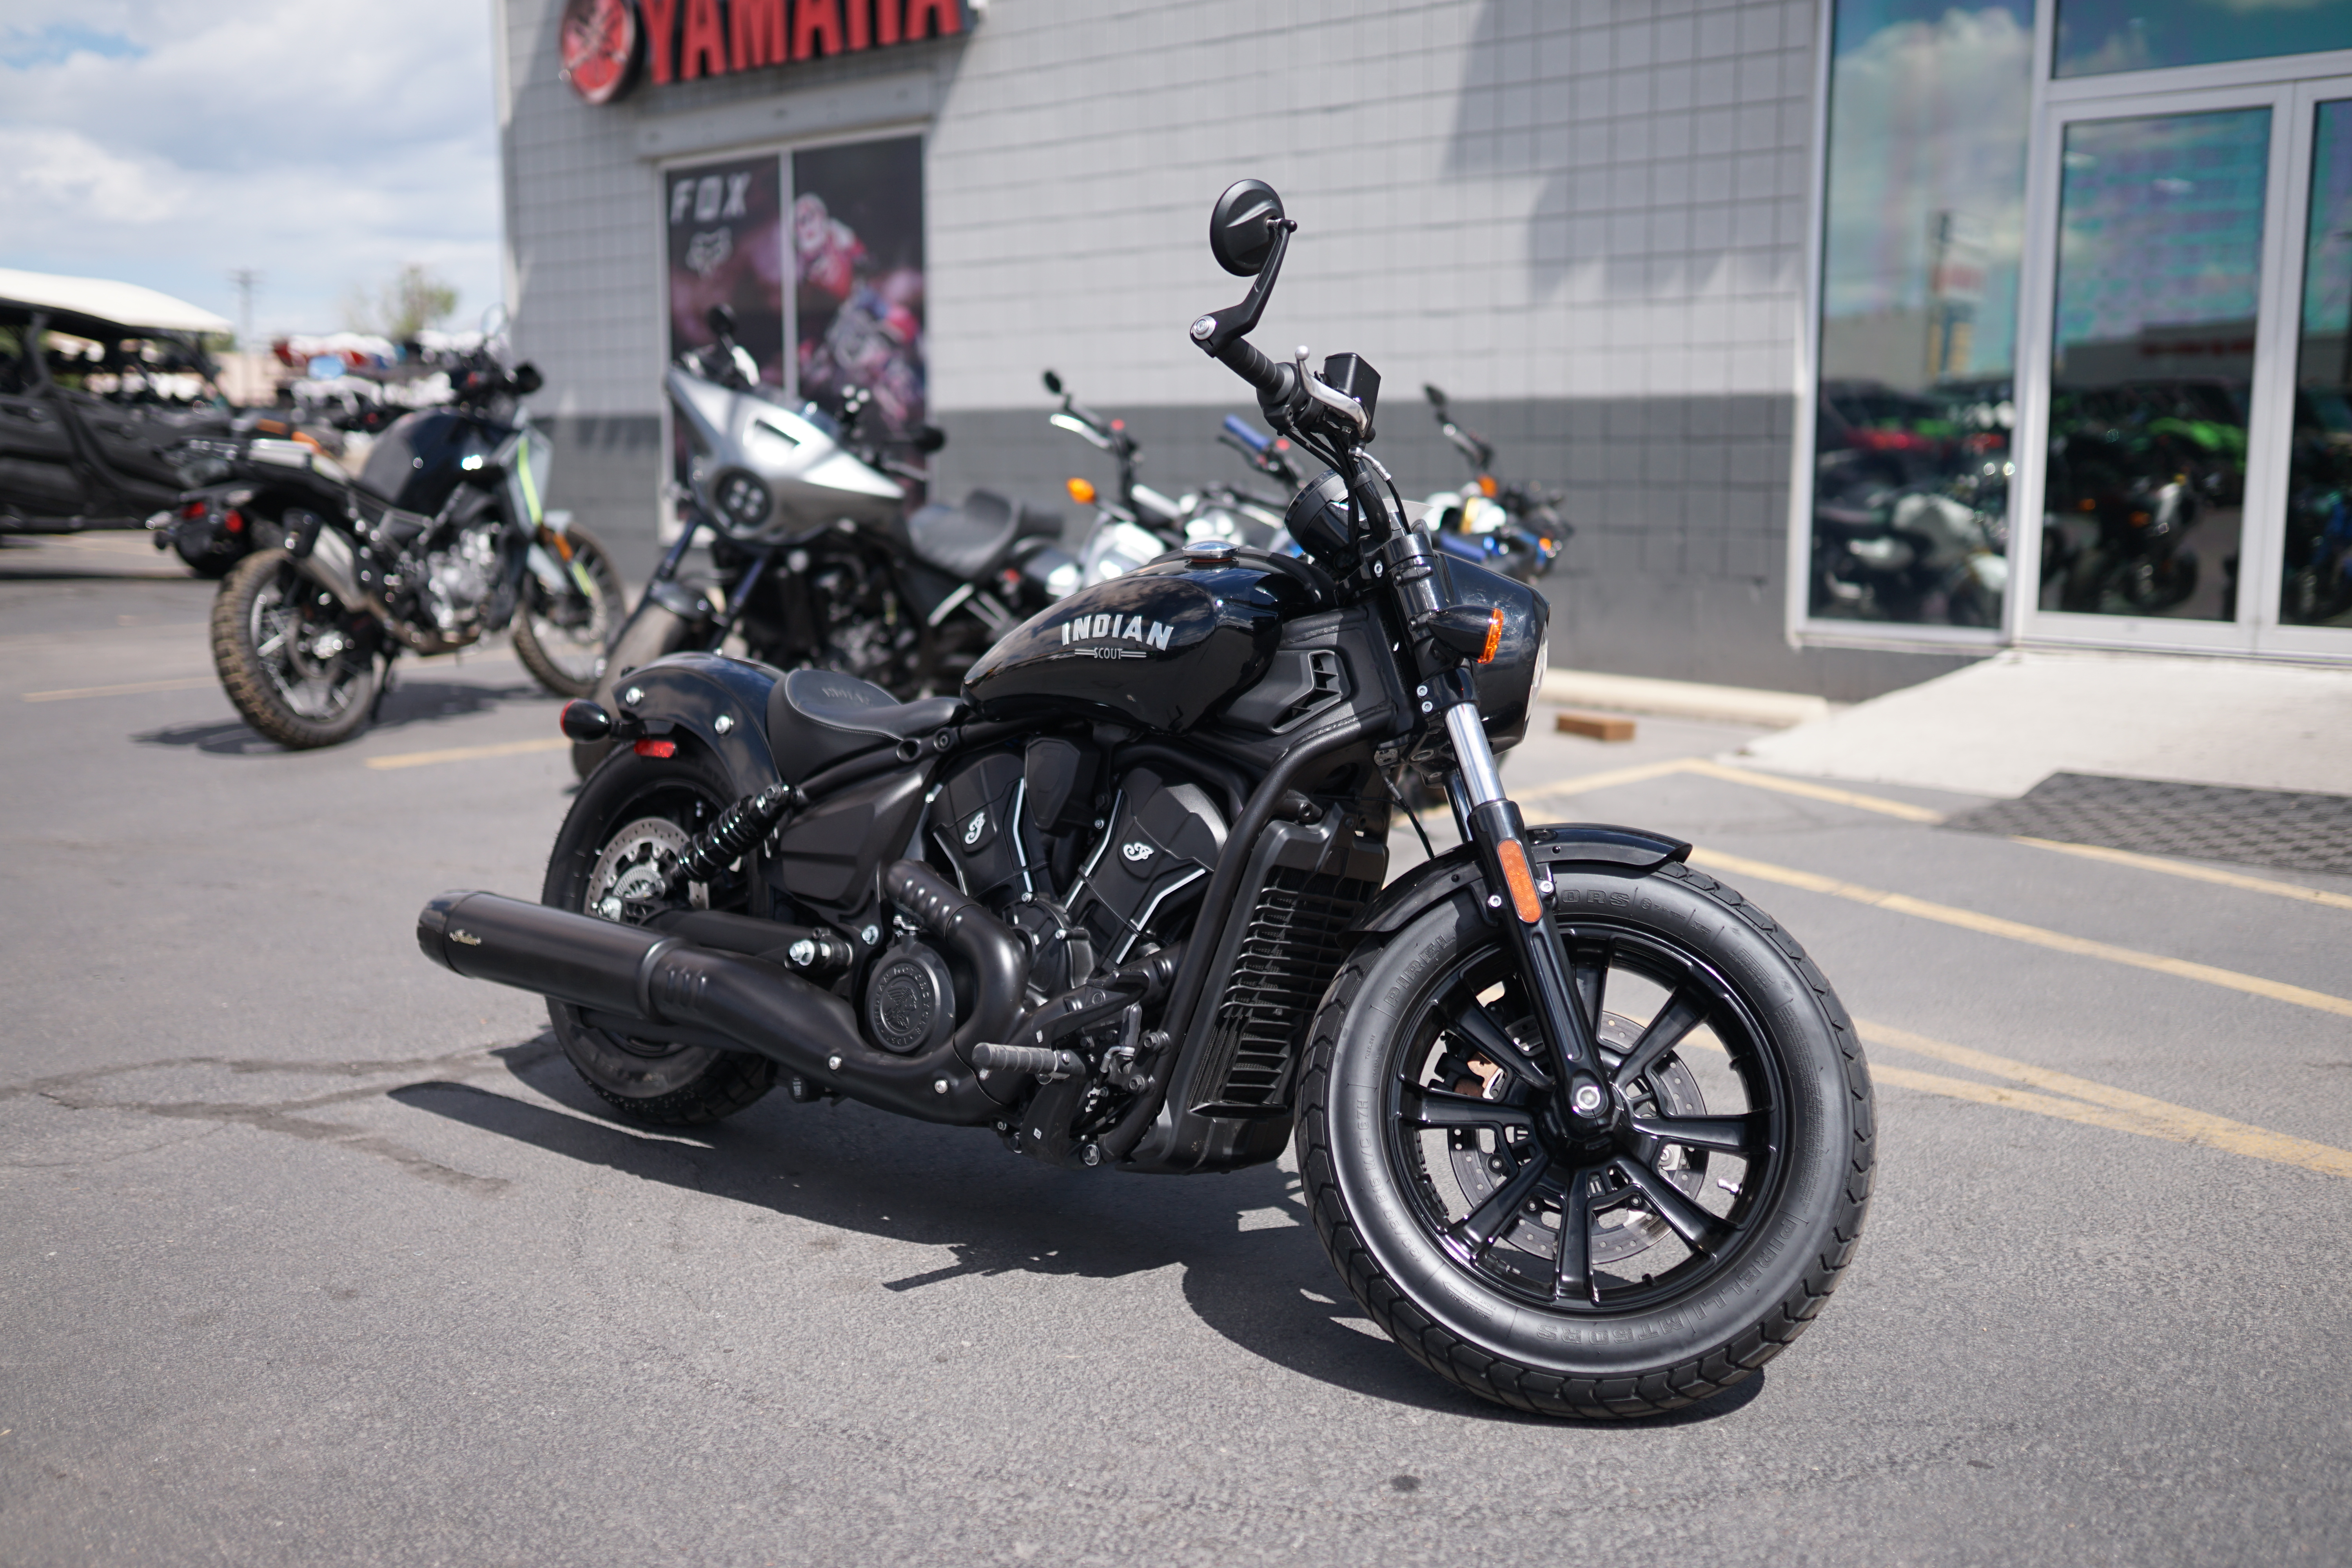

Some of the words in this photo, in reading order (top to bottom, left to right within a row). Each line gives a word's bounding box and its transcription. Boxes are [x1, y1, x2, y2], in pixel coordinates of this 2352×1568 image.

[670, 171, 751, 225] FOX
[1062, 614, 1174, 651] INDIAN
[1094, 648, 1123, 660] SCOUT
[1587, 889, 1631, 909] RS
[1357, 1098, 1369, 1131] 67H
[1358, 1138, 1376, 1171] M/C
[1368, 1176, 1388, 1204] B16
[1382, 1207, 1426, 1263] 130/90
[1691, 1216, 1799, 1321] PIRELLI
[1535, 1322, 1582, 1344] RS
[1588, 1314, 1686, 1345] MT60
